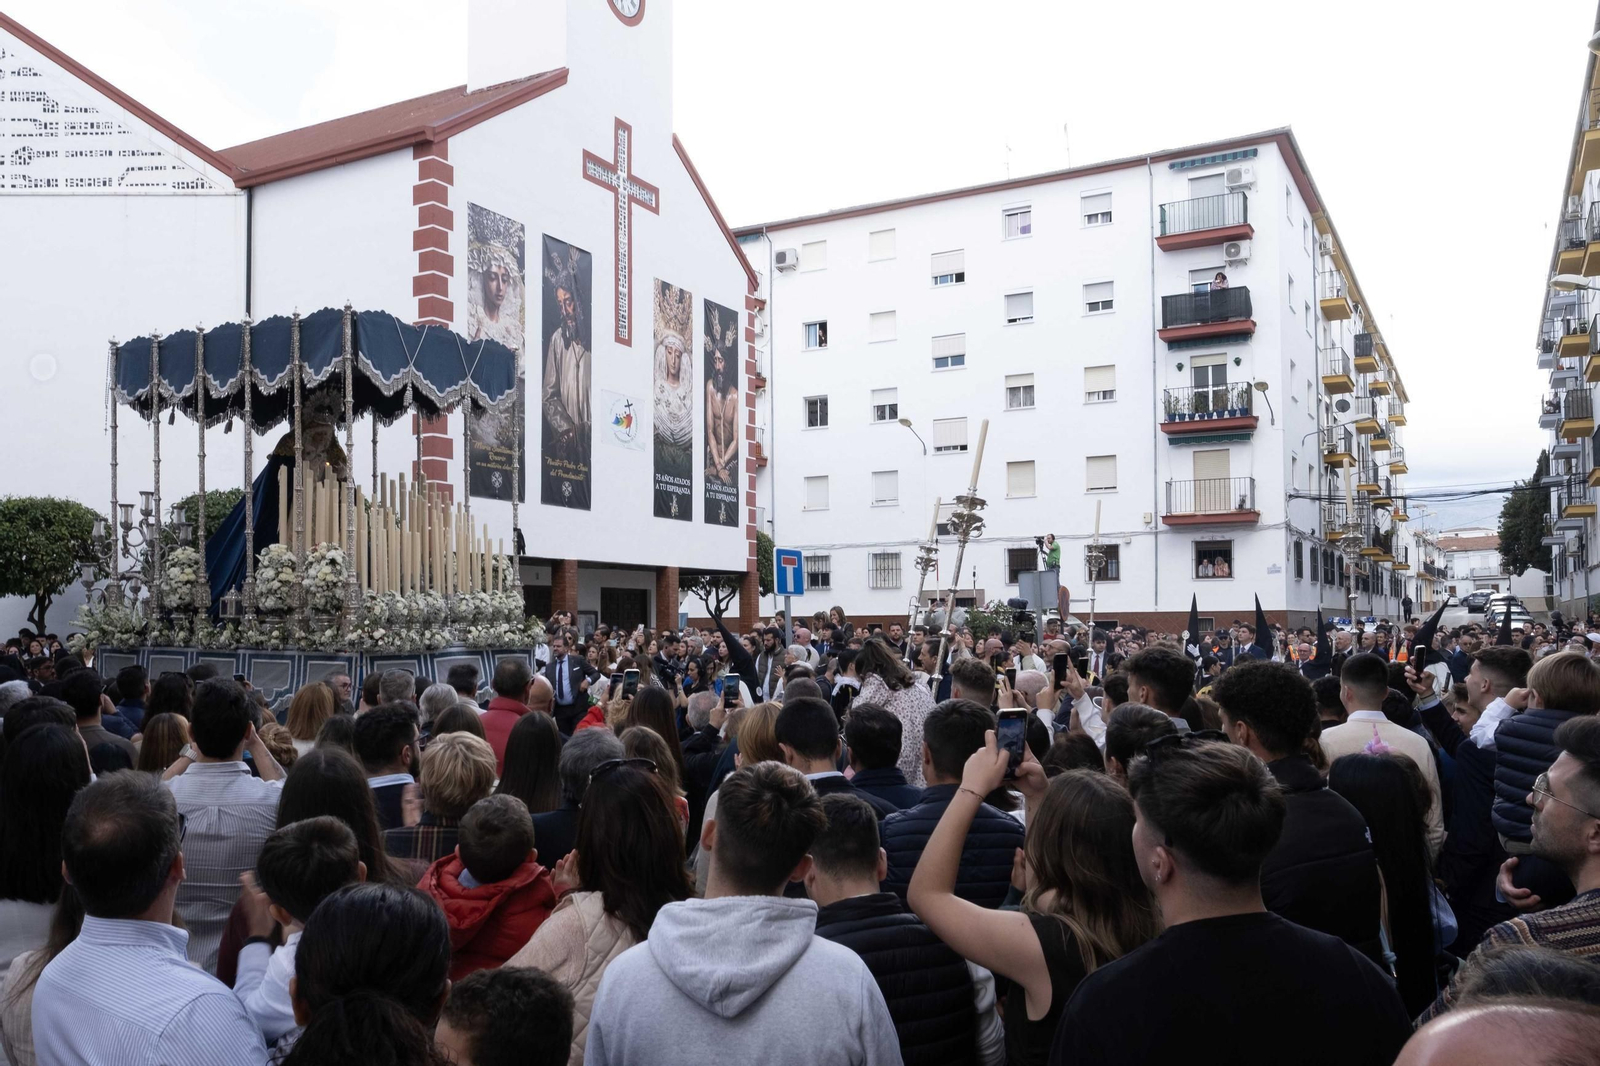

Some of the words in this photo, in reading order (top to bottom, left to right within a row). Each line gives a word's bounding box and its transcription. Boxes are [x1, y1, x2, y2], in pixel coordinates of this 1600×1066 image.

[661, 474, 674, 483] AÑOS
[674, 477, 691, 486] ATADOS
[660, 483, 667, 491] TU
[667, 484, 691, 495] ESPERANZA
[711, 483, 722, 492] AÑOS
[722, 485, 737, 494] ATADOS
[710, 491, 716, 499] TU
[716, 492, 737, 502] ESPERANZA
